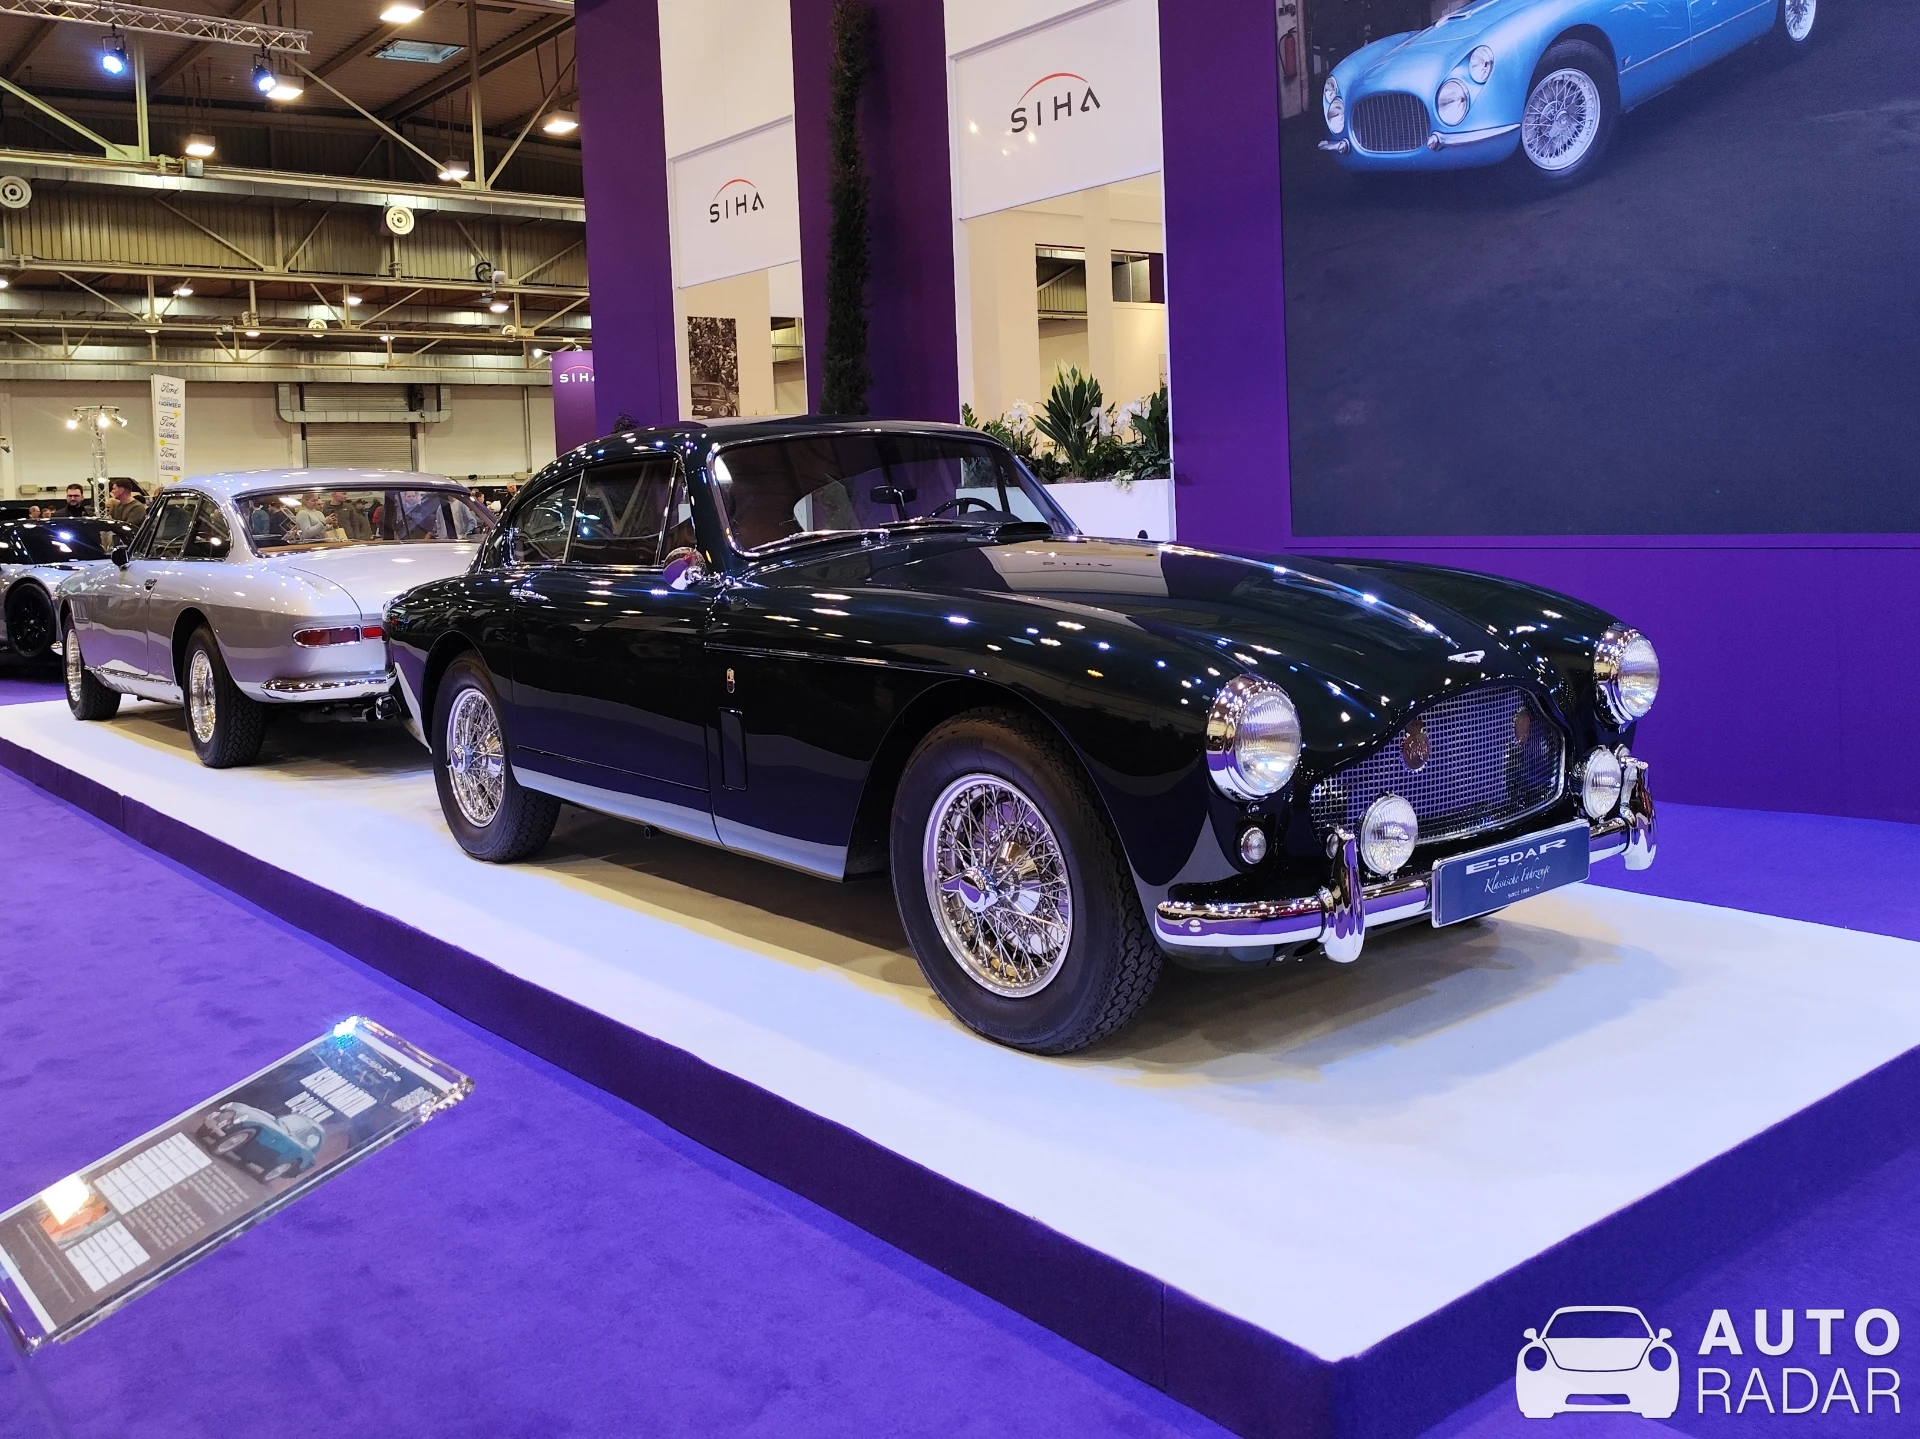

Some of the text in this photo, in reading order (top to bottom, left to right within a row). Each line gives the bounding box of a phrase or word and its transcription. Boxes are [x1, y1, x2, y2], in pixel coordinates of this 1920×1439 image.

[1011, 86, 1100, 133] SIHA
[710, 191, 764, 223] SIHA
[160, 382, 179, 394] Ford
[160, 416, 177, 428] Ford
[160, 447, 178, 458] Ford
[1465, 838, 1567, 875] ESDAR
[1484, 862, 1521, 894] Klassische
